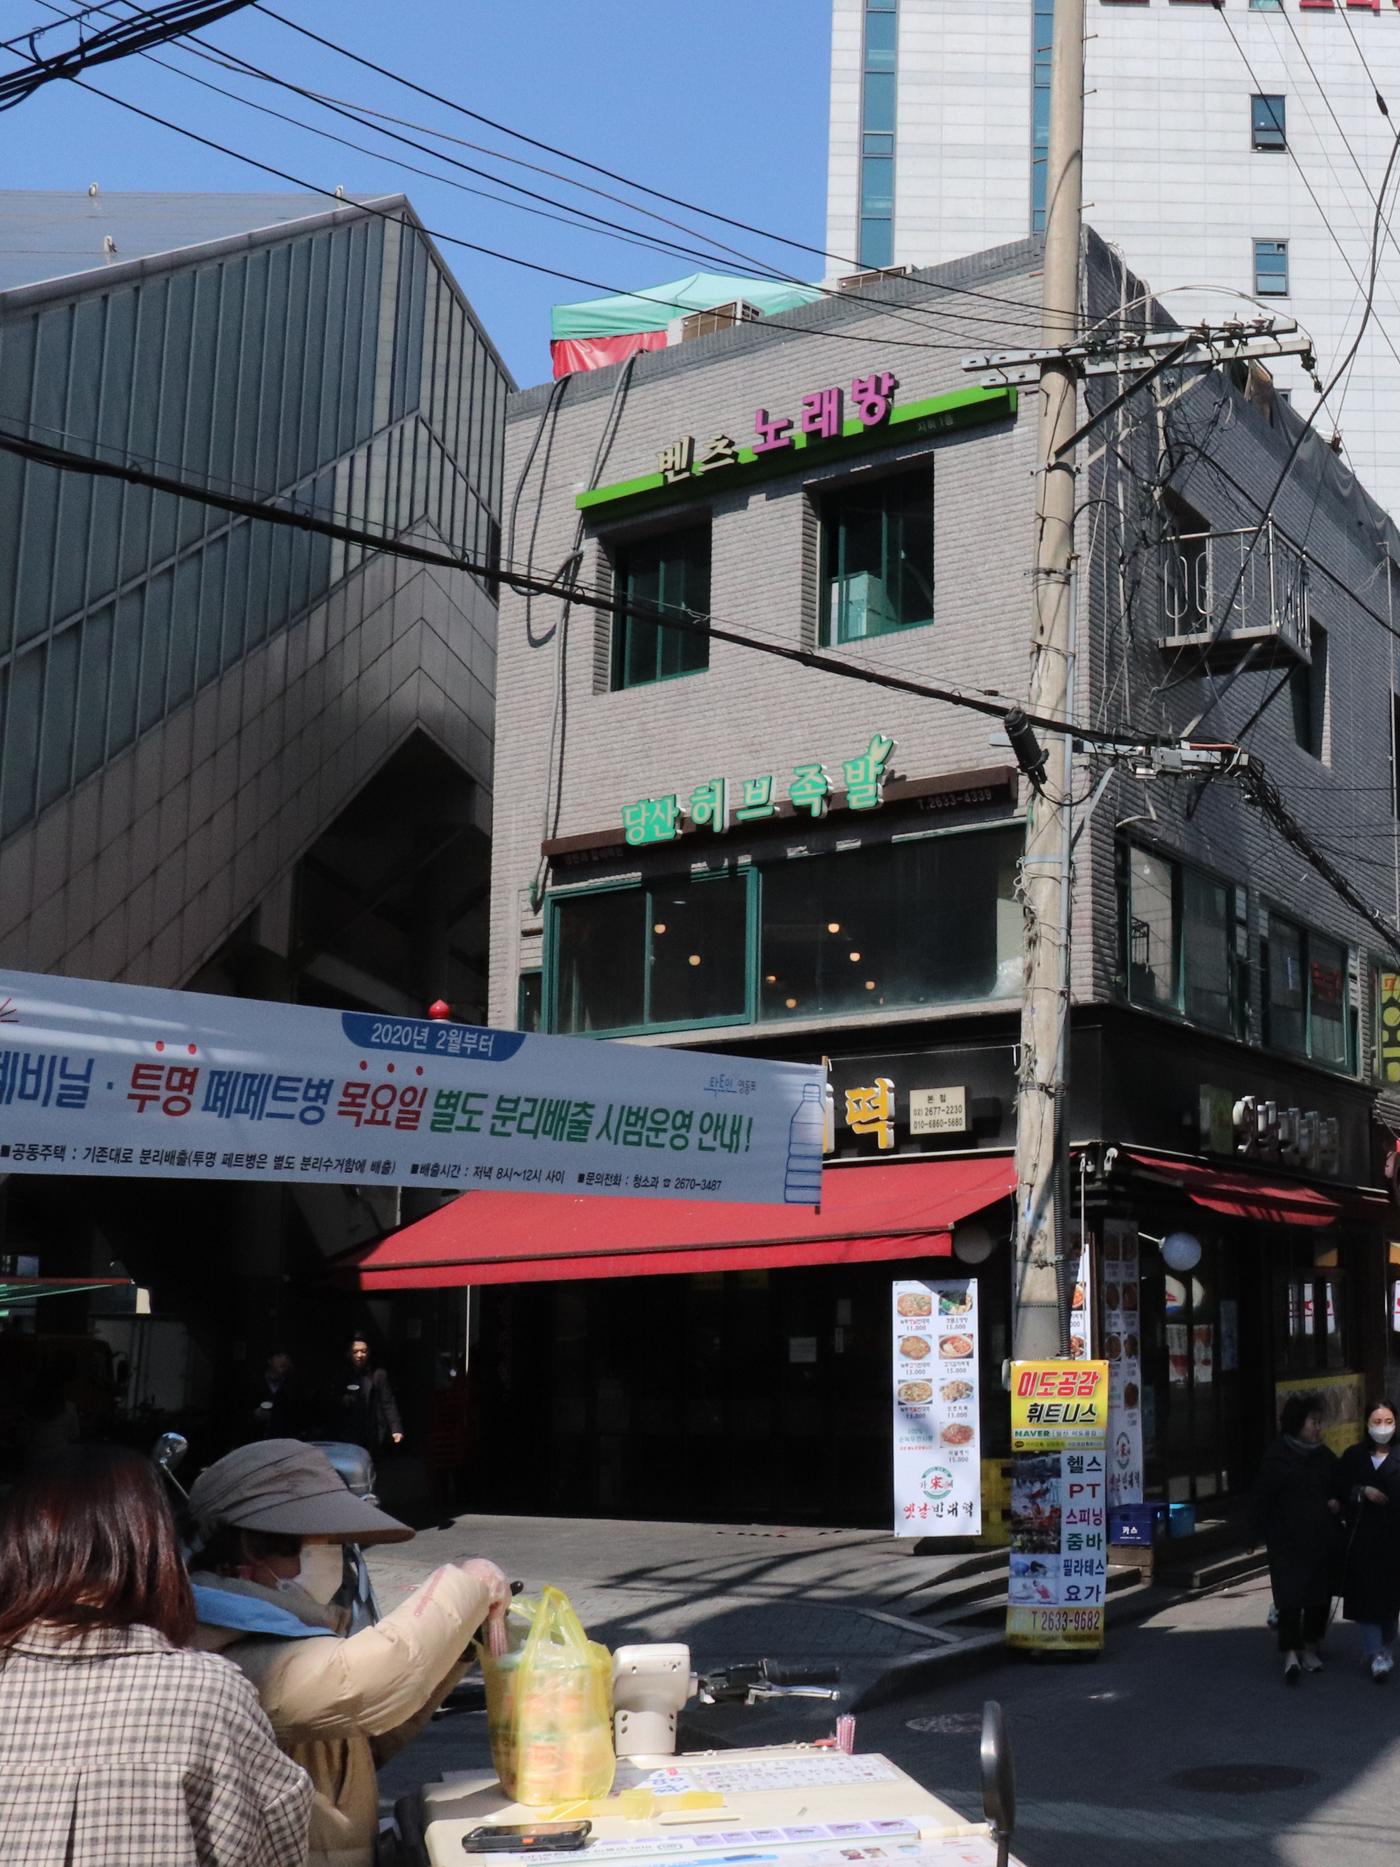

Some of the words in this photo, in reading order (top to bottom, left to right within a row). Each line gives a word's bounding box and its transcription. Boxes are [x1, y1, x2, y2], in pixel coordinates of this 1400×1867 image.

[657, 433, 740, 484] 벤츠
[750, 371, 899, 454] 노래방
[621, 792, 683, 846] 당산
[690, 748, 895, 834] 허브족발
[371, 1023, 428, 1050] 2020년
[435, 1030, 495, 1057] 2월부터
[127, 1063, 199, 1117] 투명
[201, 1069, 334, 1126] 폐페트병
[337, 1080, 428, 1131] 목요일
[430, 1088, 489, 1133] 별도
[490, 1093, 596, 1143] 분리배출
[596, 1103, 695, 1152] 시범운영
[698, 1108, 753, 1154] 안내!
[12, 1143, 66, 1162] 공동주택
[83, 1147, 133, 1165] 기존대로
[221, 1152, 268, 1169] 페트병은
[273, 1155, 295, 1171] 별도
[300, 1156, 367, 1175] 분리수거함에
[370, 1159, 397, 1176] 배출)
[473, 1166, 493, 1181] 저녁
[545, 1169, 565, 1184] 사이
[633, 1175, 660, 1190] 청소과
[674, 1177, 722, 1192] 2670-3487
[1017, 1370, 1099, 1397] 이도공감
[1026, 1403, 1097, 1424] 휘트니스
[1014, 1430, 1050, 1438] NAVER
[1066, 1455, 1102, 1474] 헬스
[1068, 1483, 1101, 1499] PT
[1065, 1507, 1104, 1526] 스피닝
[1065, 1533, 1102, 1551] 줌바
[1063, 1558, 1105, 1577] 필라테스
[1065, 1584, 1101, 1603] 요가
[1041, 1610, 1100, 1631] 2633-9682
